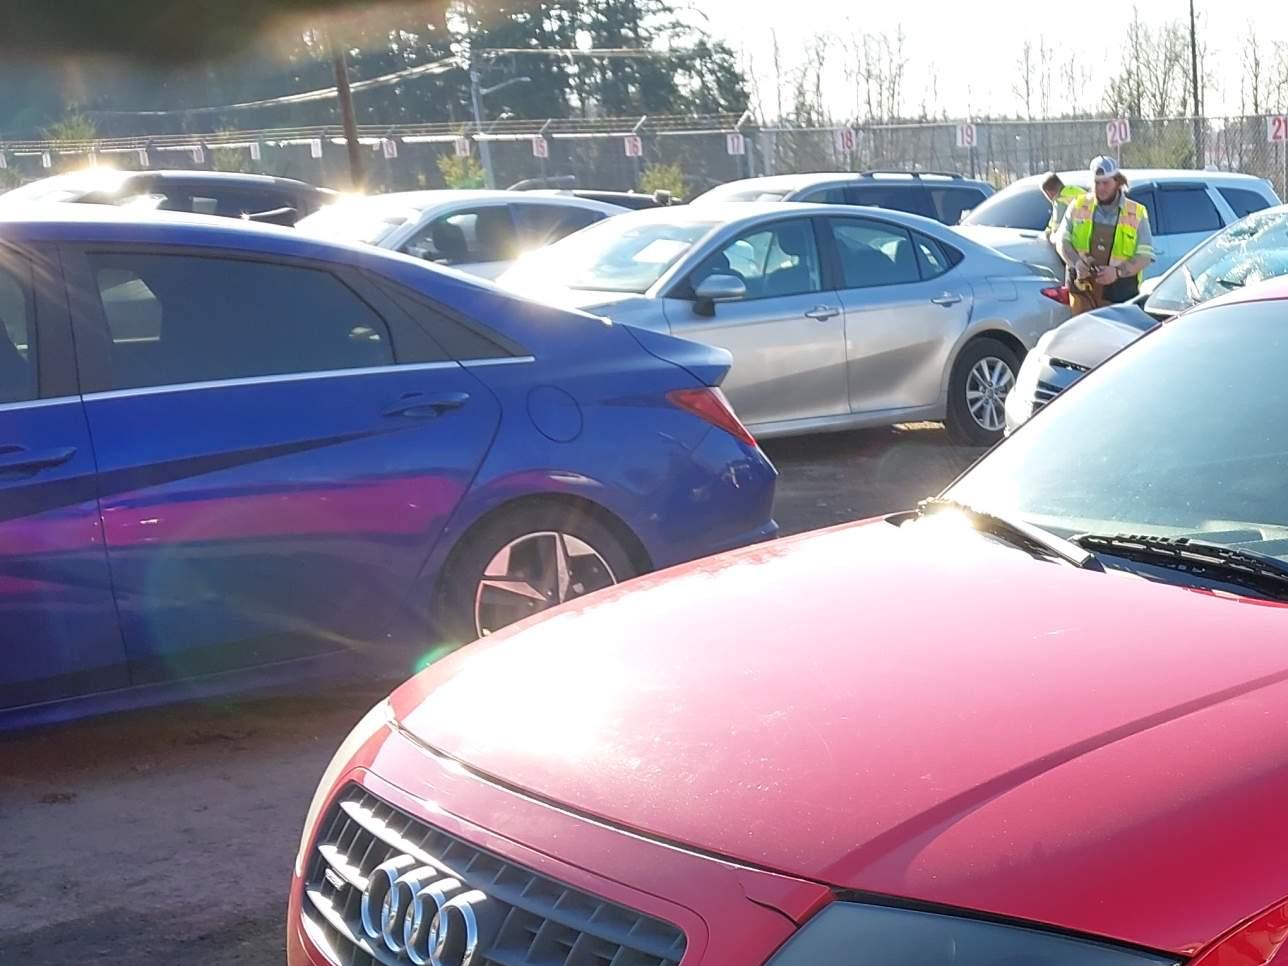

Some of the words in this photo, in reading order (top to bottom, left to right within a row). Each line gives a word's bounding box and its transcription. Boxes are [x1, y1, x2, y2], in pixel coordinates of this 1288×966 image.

[840, 127, 854, 150] 18
[960, 124, 974, 145] 19
[1108, 120, 1128, 144] 20
[1271, 117, 1288, 140] 21
[627, 137, 640, 155] 16
[730, 135, 741, 153] 17
